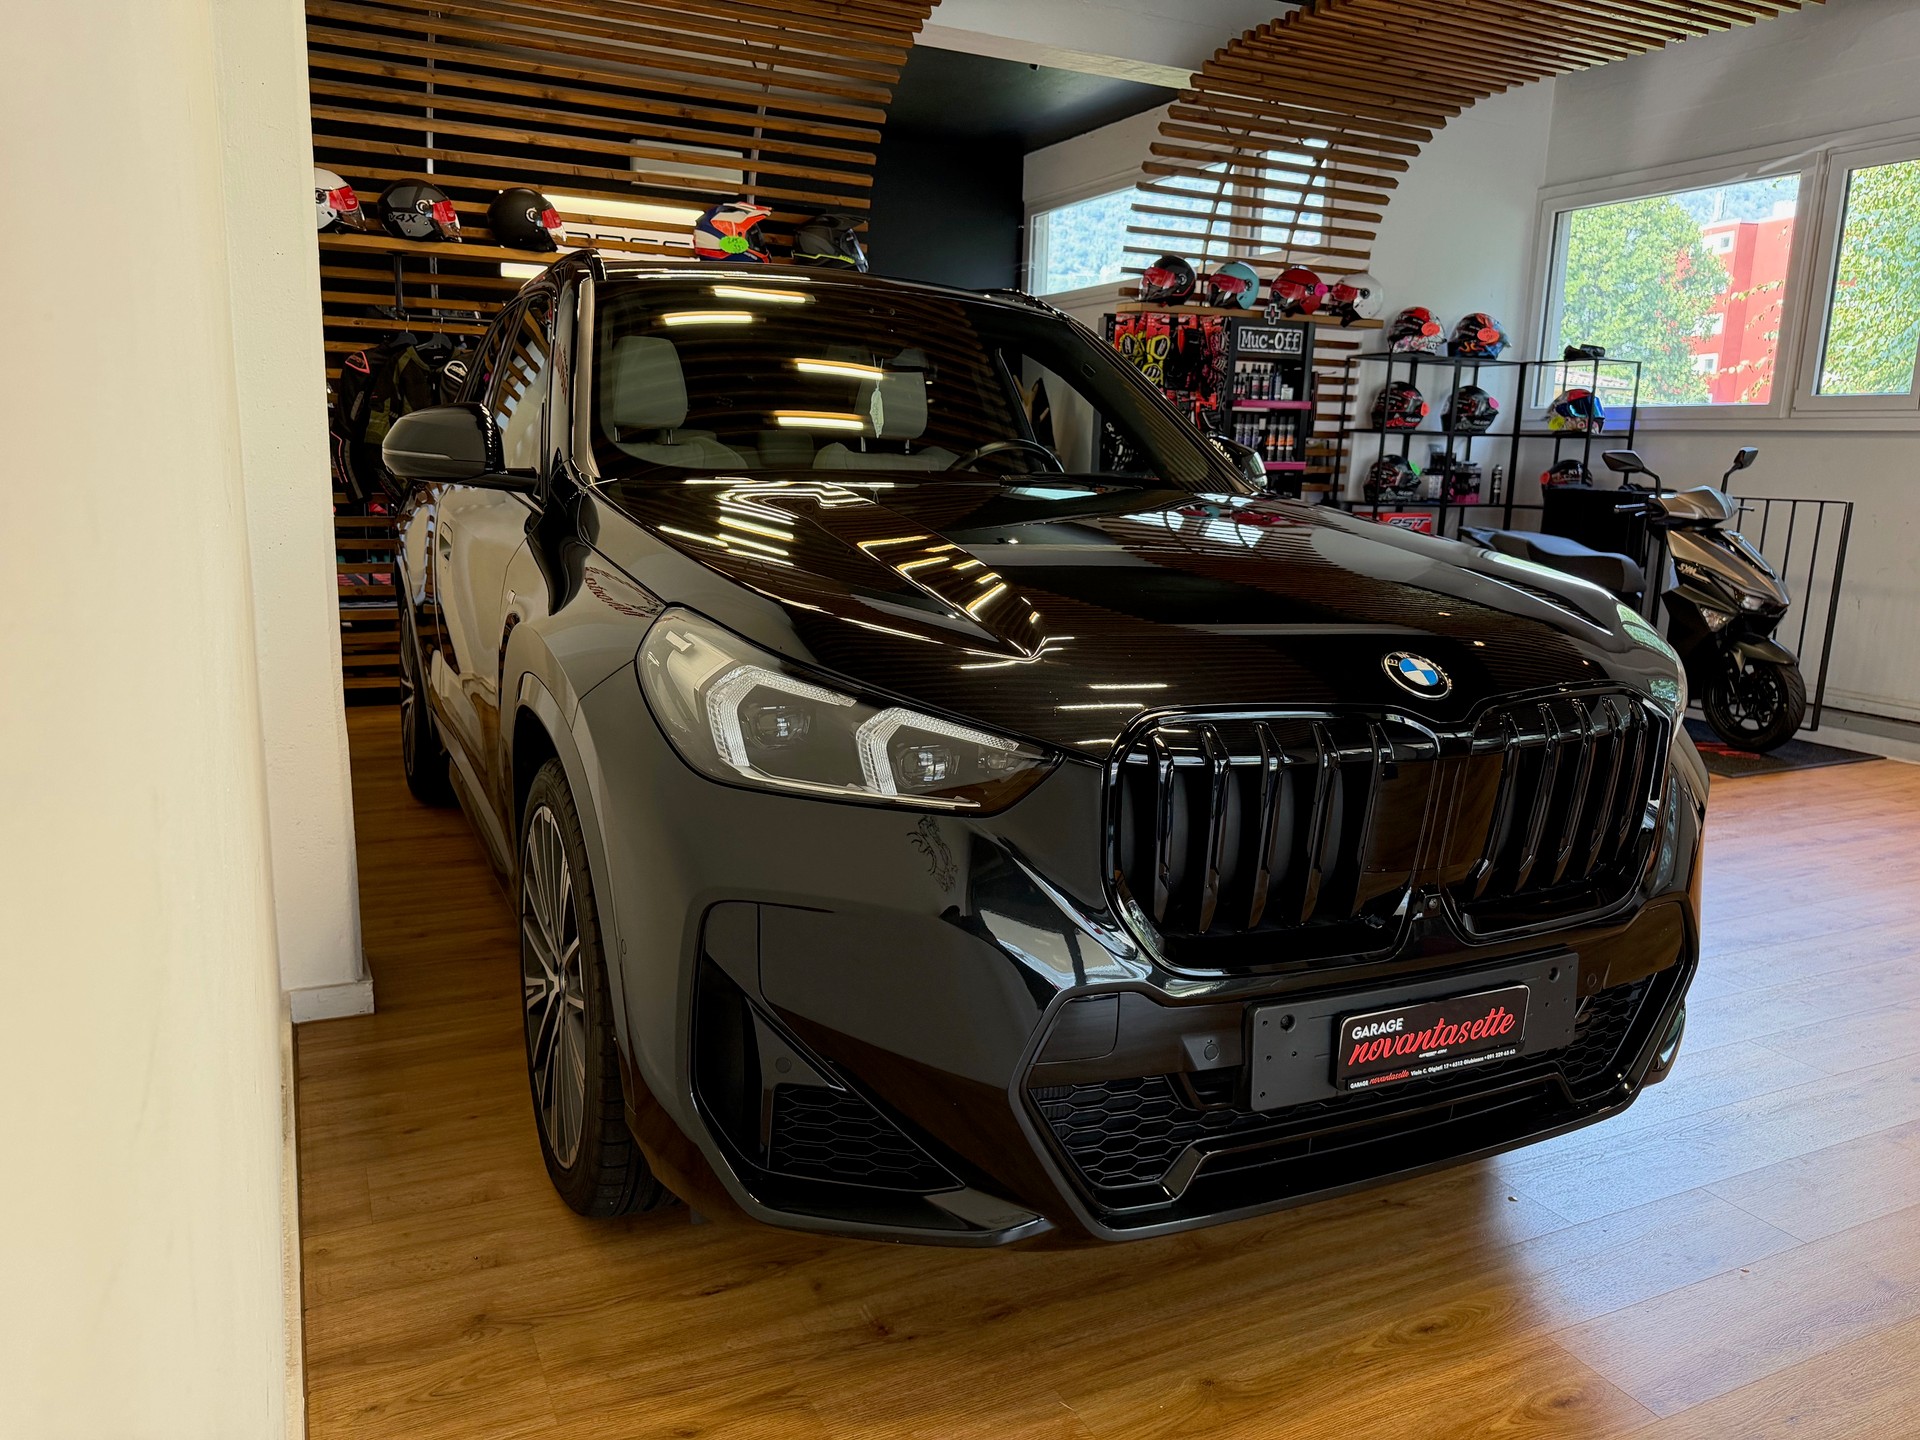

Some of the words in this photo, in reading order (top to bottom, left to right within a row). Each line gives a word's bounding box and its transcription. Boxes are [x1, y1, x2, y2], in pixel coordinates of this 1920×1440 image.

[1240, 330, 1300, 351] Muc-Off
[1348, 1006, 1516, 1066] novantasette
[1352, 1018, 1404, 1040] GARAGE
[1350, 1080, 1369, 1089] GARAGE
